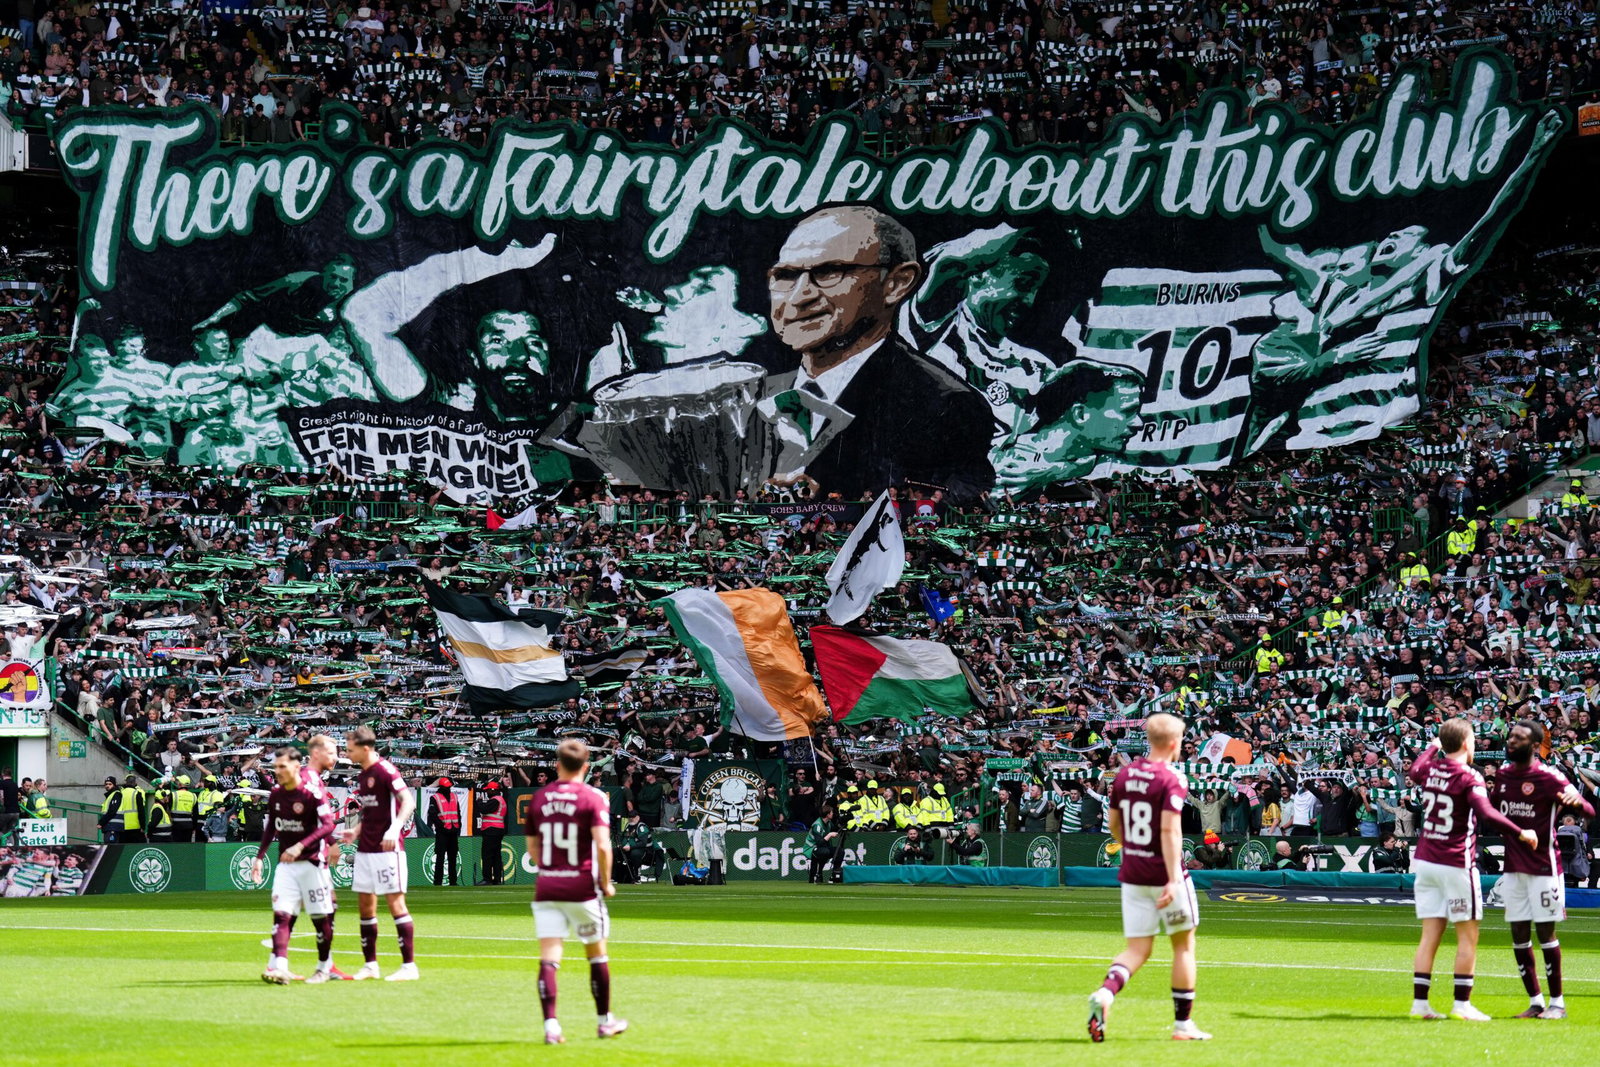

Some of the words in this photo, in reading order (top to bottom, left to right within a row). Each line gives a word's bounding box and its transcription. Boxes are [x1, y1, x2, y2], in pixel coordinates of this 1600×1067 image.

[407, 153, 478, 212] a
[889, 127, 1151, 215] about
[1160, 101, 1327, 228] this
[1334, 61, 1527, 197] club
[1536, 243, 1576, 259] CELTIC
[1156, 282, 1242, 306] BURNS
[1541, 345, 1574, 356] CELTIC
[1137, 326, 1232, 404] 10
[349, 410, 379, 425] night
[381, 413, 393, 426] in
[395, 415, 435, 426] history
[437, 415, 447, 426] of
[449, 420, 455, 429] a
[1142, 420, 1188, 443] RIP
[302, 427, 367, 452] TEN
[378, 431, 450, 460] MEN
[455, 438, 519, 470] WIN
[311, 449, 377, 477] THE
[770, 506, 794, 514] BOHS
[795, 504, 820, 513] BABY
[821, 503, 847, 513] CREW
[700, 768, 729, 795] GREEN
[730, 768, 763, 789] BRIGA
[1423, 791, 1454, 835] 23
[1508, 801, 1534, 810] Stellar
[31, 823, 55, 833] Exit
[1119, 799, 1152, 845] 18
[21, 835, 48, 845] Gate
[52, 835, 66, 845] 14
[539, 822, 579, 867] 14
[732, 836, 867, 877] dafaet
[377, 868, 390, 884] 15
[308, 888, 325, 903] 89
[1540, 890, 1550, 908] 6
